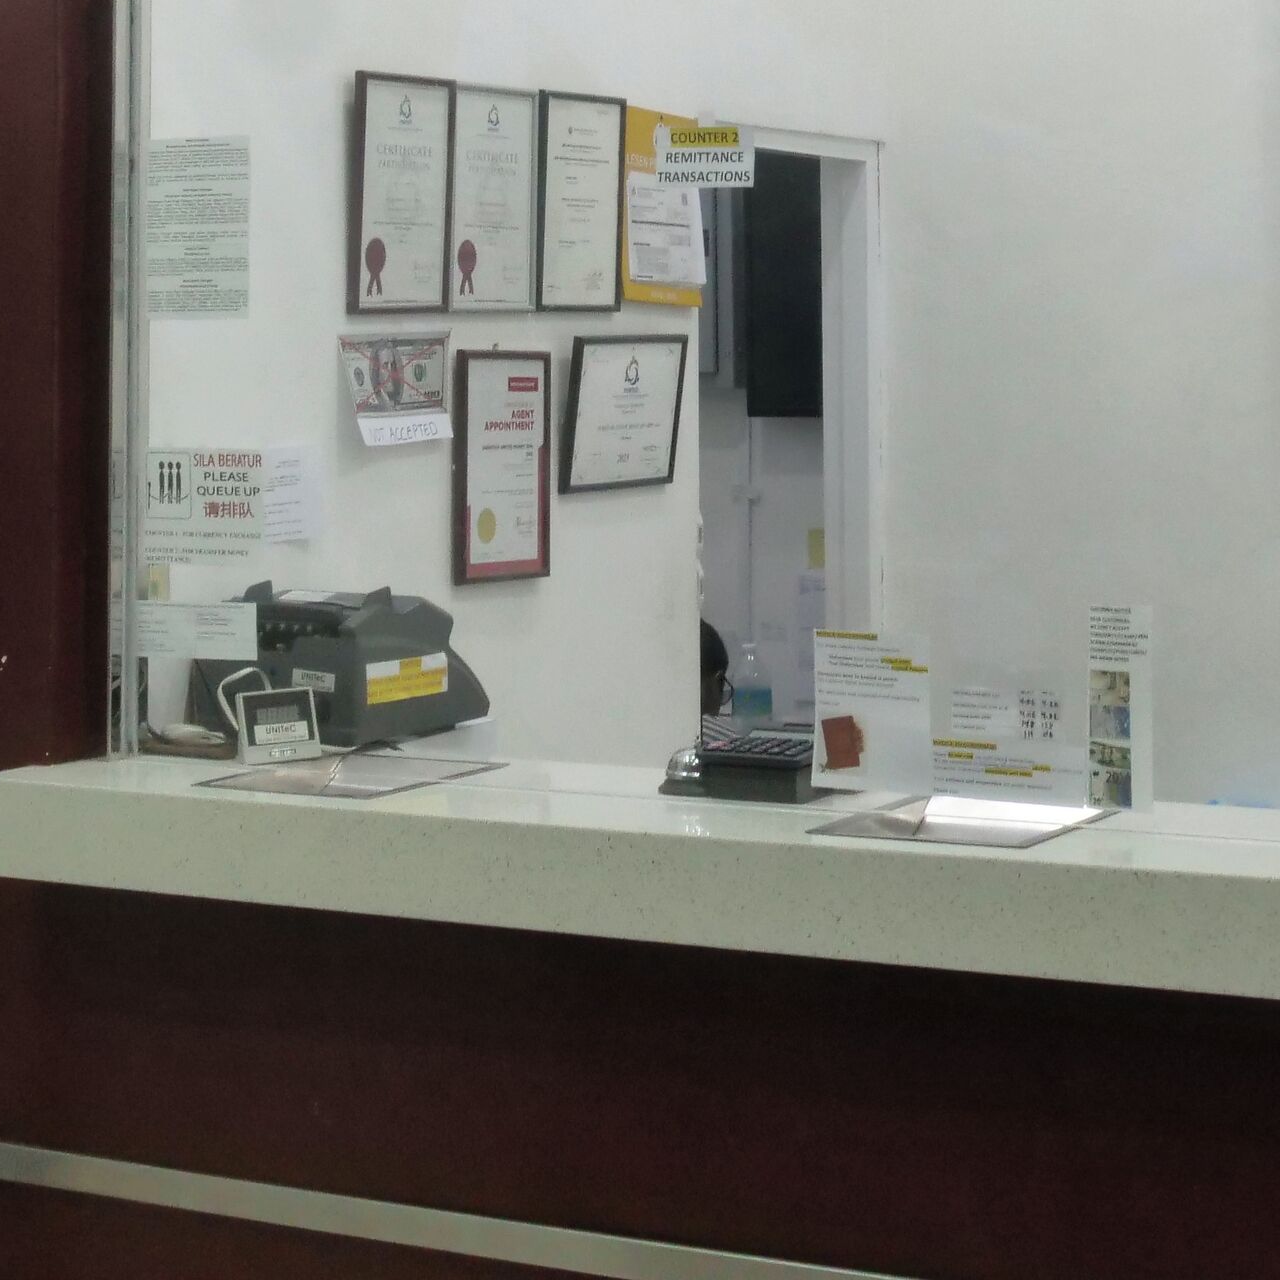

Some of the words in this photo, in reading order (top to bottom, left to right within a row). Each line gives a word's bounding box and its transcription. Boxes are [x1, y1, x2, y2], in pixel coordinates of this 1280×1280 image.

[671, 132, 728, 144] COUNTER
[732, 132, 738, 142] 2
[666, 152, 744, 163] REMITTANCE
[658, 171, 750, 182] TRANSACTIONS
[511, 410, 534, 419] AGENT
[390, 421, 437, 441] ACCEPTED
[484, 421, 534, 431] APPOINTMENT
[194, 454, 215, 467] SILA
[219, 454, 262, 467] BERATUR
[204, 472, 248, 482] PLEASE
[197, 486, 241, 497] QUEUE
[244, 488, 260, 497] UP
[203, 502, 254, 518] 请排队
